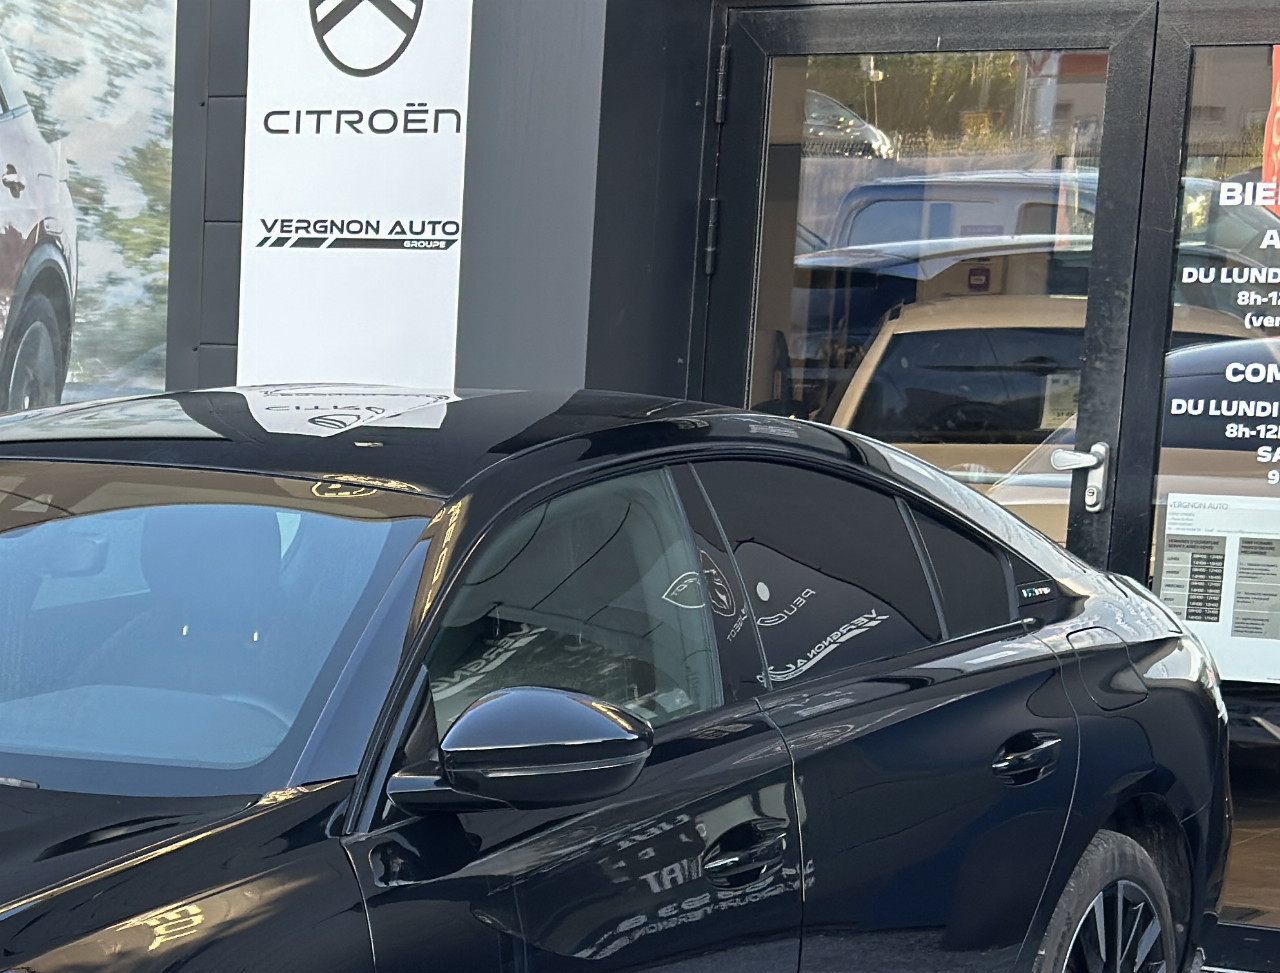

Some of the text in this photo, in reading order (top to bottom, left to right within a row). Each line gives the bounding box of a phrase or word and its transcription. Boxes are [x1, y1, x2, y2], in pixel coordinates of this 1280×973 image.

[263, 102, 461, 135] CITROËN
[1219, 182, 1280, 206] BIE
[260, 218, 460, 237] VERGNON AUTO
[403, 240, 447, 249] GROUPE
[1182, 267, 1216, 284] DU
[1237, 290, 1280, 306] 8h-1
[1171, 399, 1279, 418] DU LUNDI
[1225, 423, 1280, 439] 8h-12
